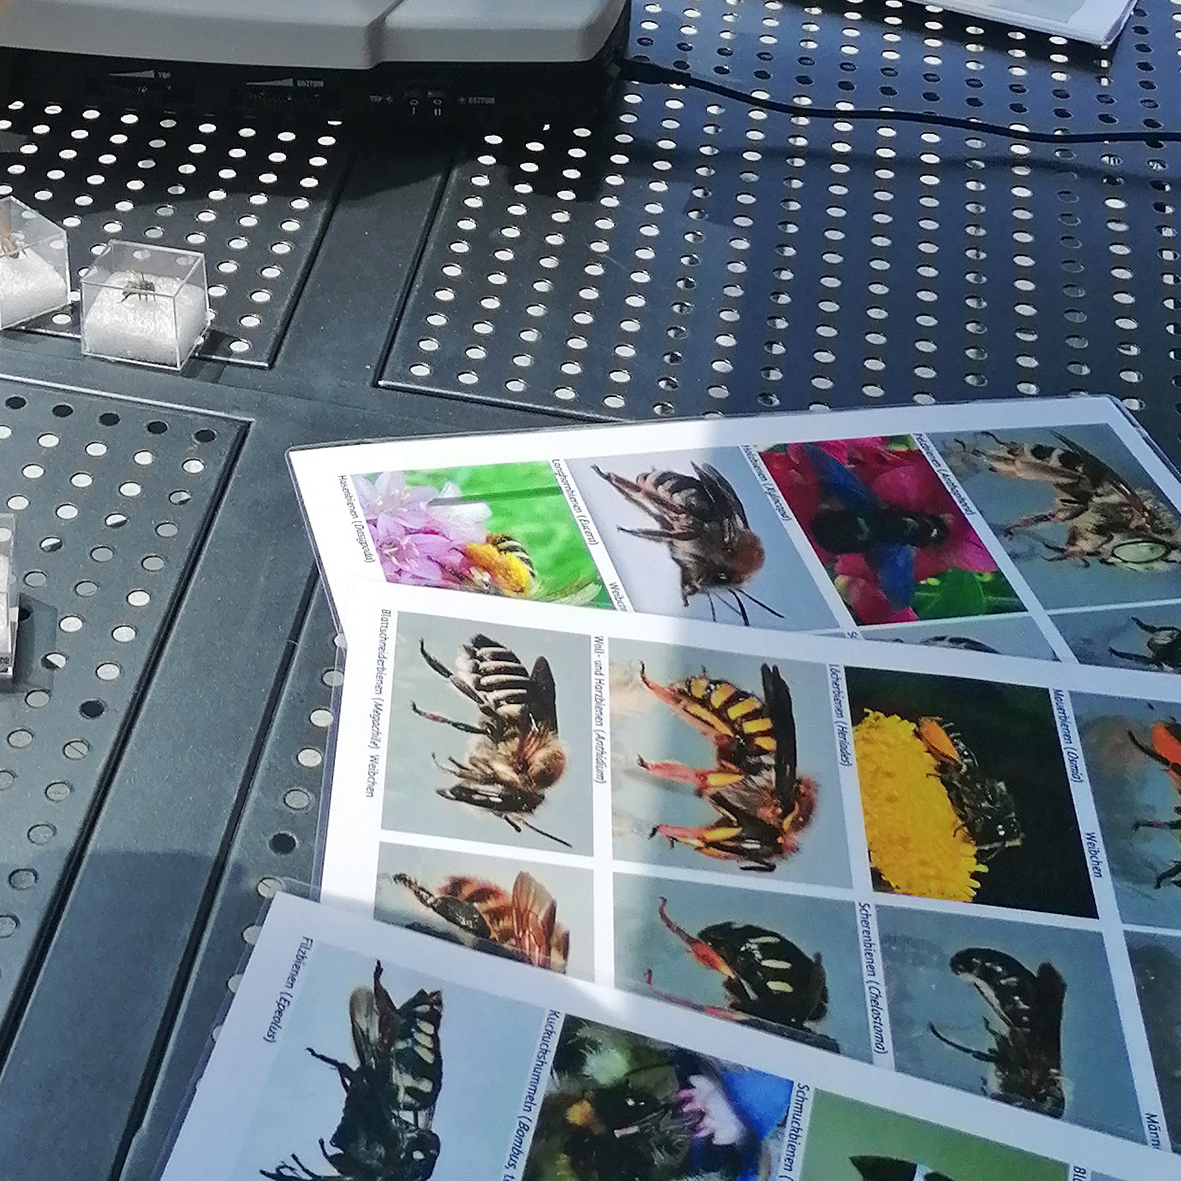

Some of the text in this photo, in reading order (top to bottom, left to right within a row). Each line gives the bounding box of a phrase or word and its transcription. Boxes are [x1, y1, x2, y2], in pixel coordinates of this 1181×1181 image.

[366, 609, 391, 797] Blattschneiderbienen (Megachile) Weibchen
[594, 660, 604, 676] und
[595, 678, 605, 726] Harzbienen
[1053, 689, 1103, 878] Mauerbienen (Osmia) Weibchen
[263, 937, 313, 1043] Filzbienen (Epeolus)
[859, 902, 888, 1054] Scherenbienen (Chelostoma)
[523, 1010, 560, 1112] Kuckuckshummeln
[505, 1116, 532, 1169] (Bombus,
[784, 1083, 809, 1172] Schmuckbienen
